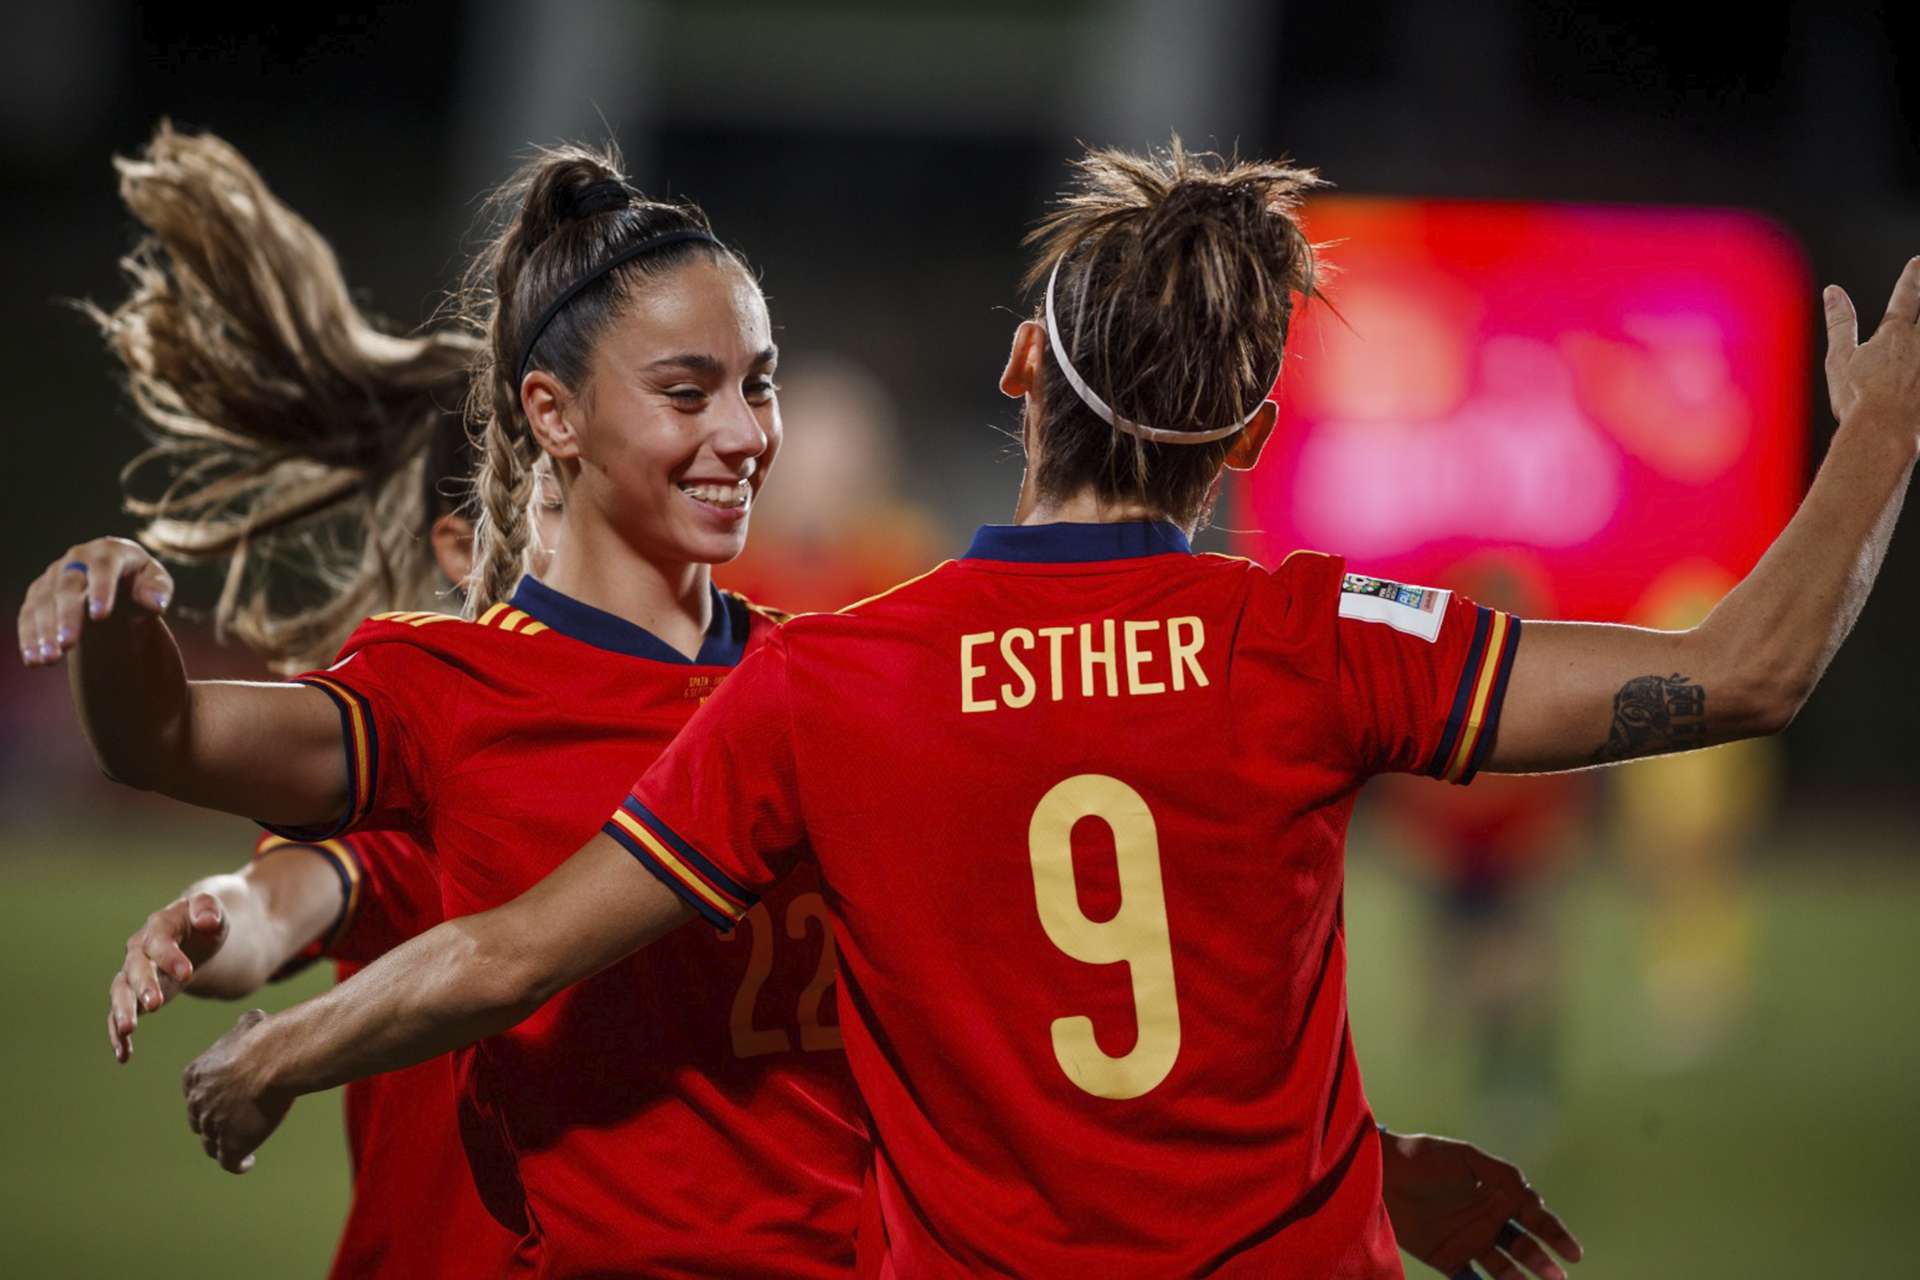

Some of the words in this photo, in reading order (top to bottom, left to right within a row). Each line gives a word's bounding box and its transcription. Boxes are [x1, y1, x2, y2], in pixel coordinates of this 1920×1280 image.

[961, 616, 1210, 713] ESTHER
[716, 892, 845, 1059] 22
[1028, 774, 1181, 1100] 9
